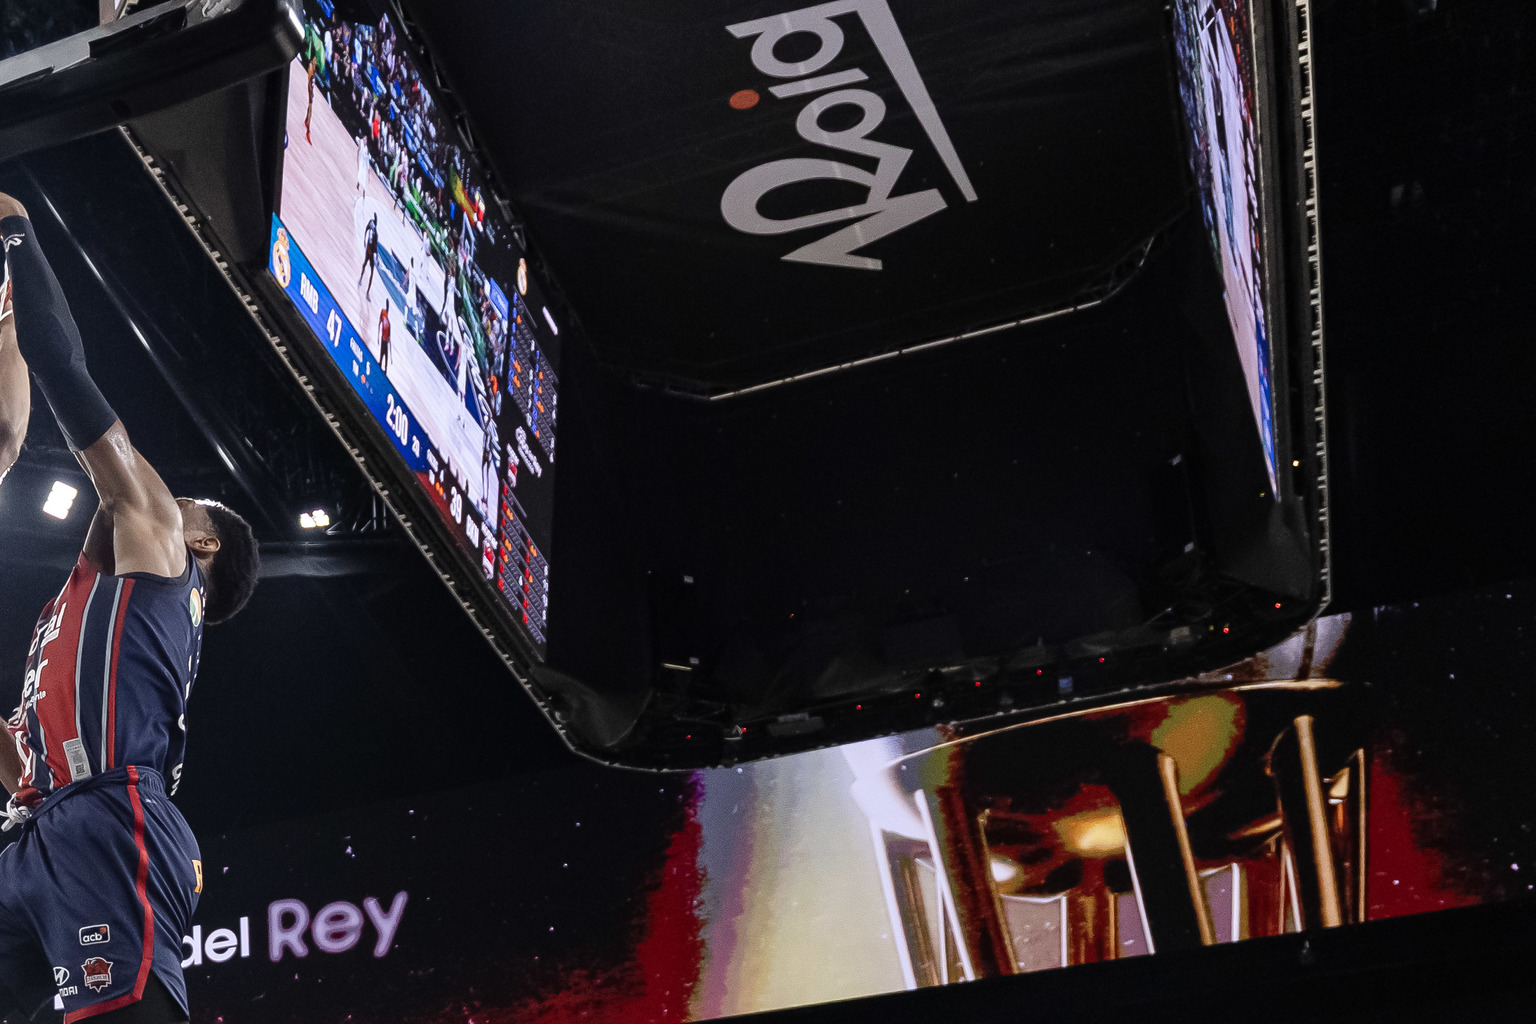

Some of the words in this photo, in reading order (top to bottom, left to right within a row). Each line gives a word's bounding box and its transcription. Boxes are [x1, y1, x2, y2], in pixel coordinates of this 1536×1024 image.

[326, 308, 342, 348] 47
[386, 393, 408, 446] 2:00
[450, 486, 462, 524] 39
[83, 932, 103, 943] acb
[180, 916, 250, 968] del
[267, 890, 409, 963] Rey
